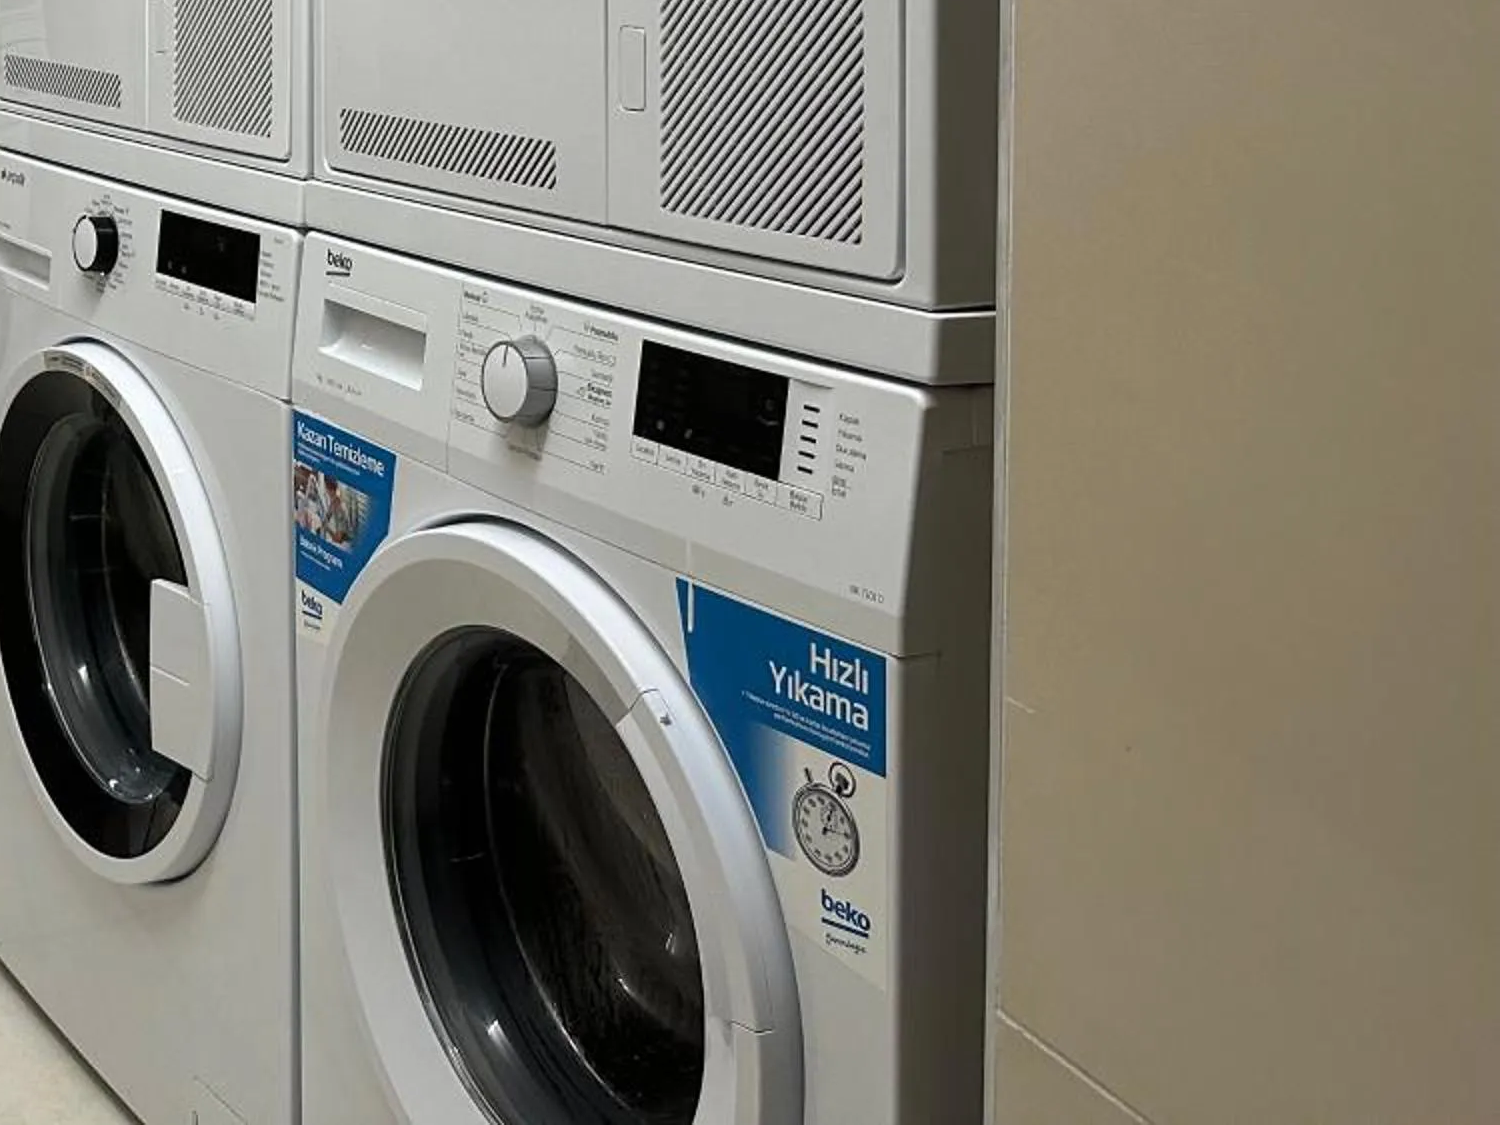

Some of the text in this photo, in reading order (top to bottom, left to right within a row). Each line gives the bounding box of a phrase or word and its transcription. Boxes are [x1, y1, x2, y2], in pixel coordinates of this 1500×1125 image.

[326, 248, 353, 271] beko
[296, 420, 327, 449] Kazan
[327, 434, 386, 478] Temizleme
[301, 588, 323, 615] beko
[810, 642, 869, 695] Hızlı
[768, 660, 869, 732] Yıkama
[821, 887, 871, 932] beko
